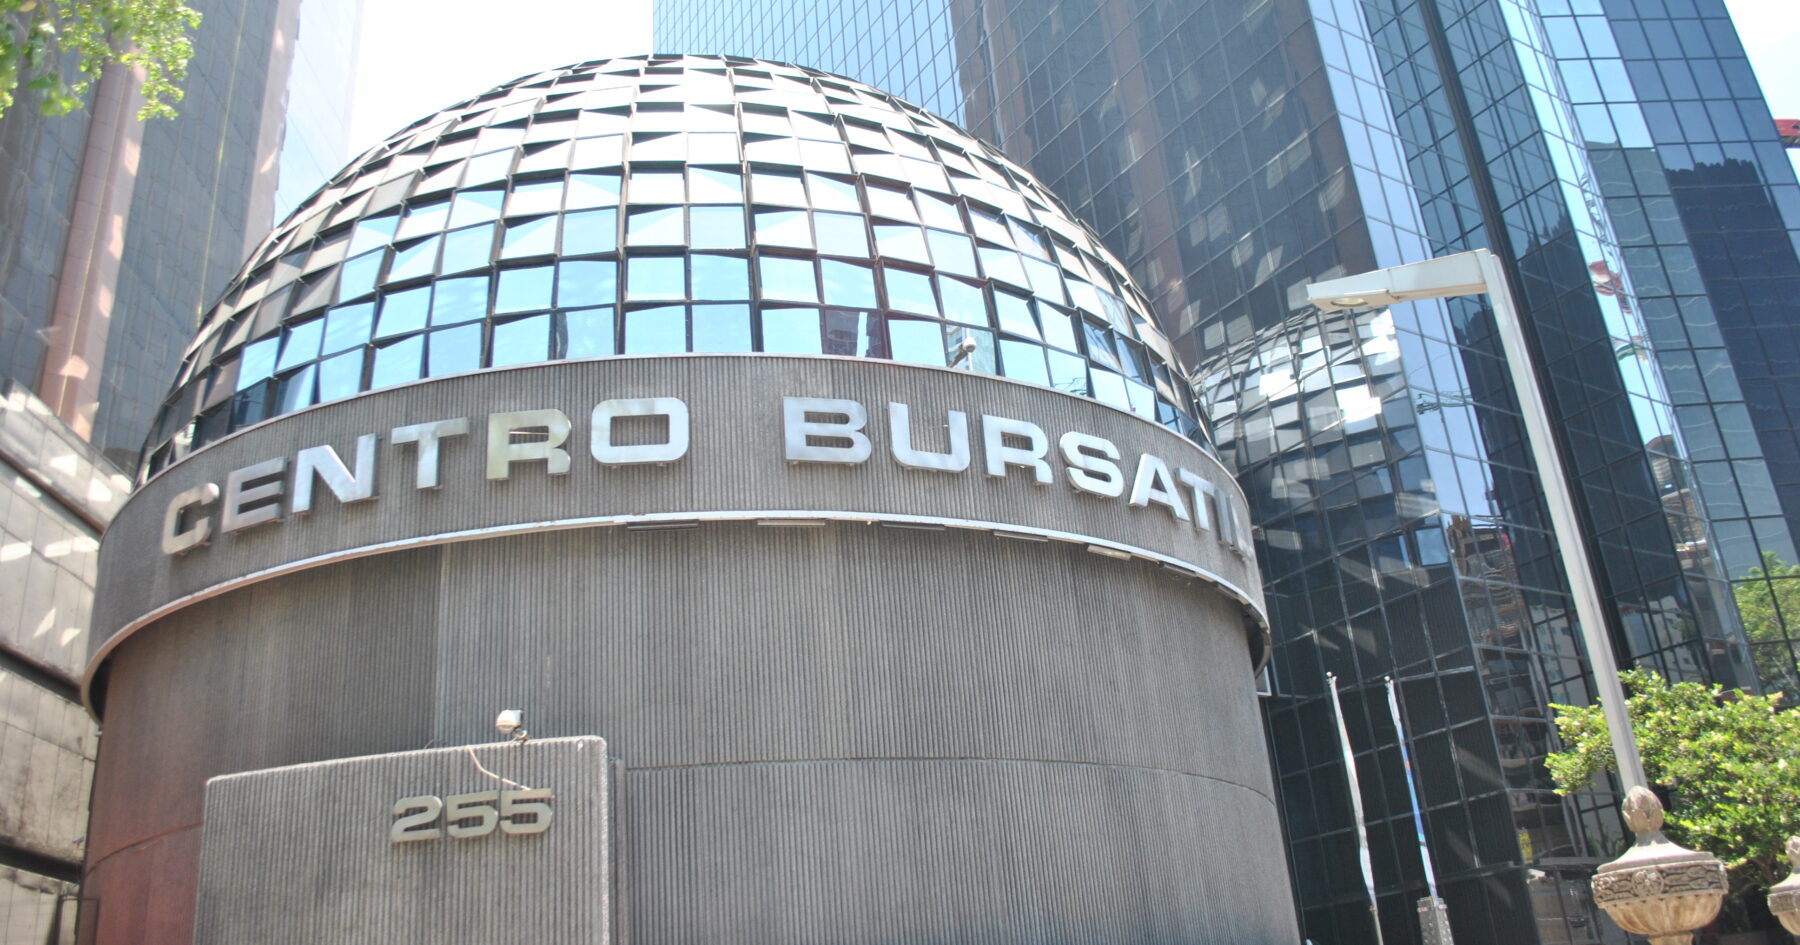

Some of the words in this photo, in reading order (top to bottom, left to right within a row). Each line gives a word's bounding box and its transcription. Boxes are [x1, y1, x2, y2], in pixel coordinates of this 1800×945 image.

[161, 396, 690, 556] CENTRO
[782, 396, 1255, 560] BURSATIL
[390, 787, 554, 844] 255
